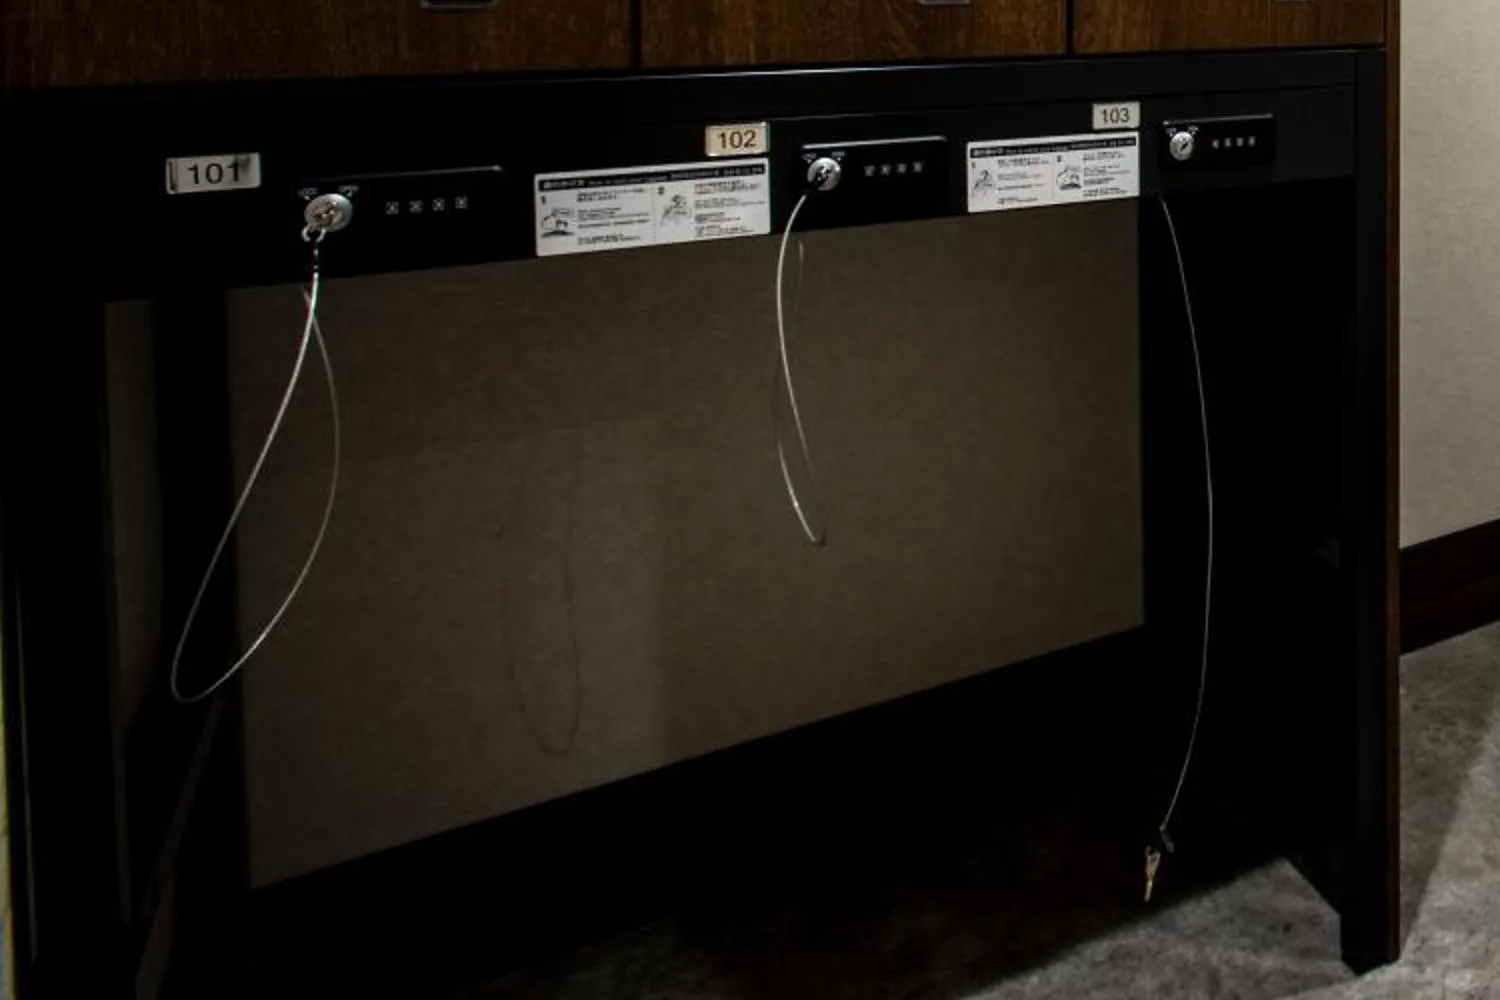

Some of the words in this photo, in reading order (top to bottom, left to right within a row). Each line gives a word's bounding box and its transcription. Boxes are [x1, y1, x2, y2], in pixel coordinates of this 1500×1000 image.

[1100, 107, 1131, 124] 103
[717, 129, 757, 150] 102
[187, 162, 242, 186] 101
